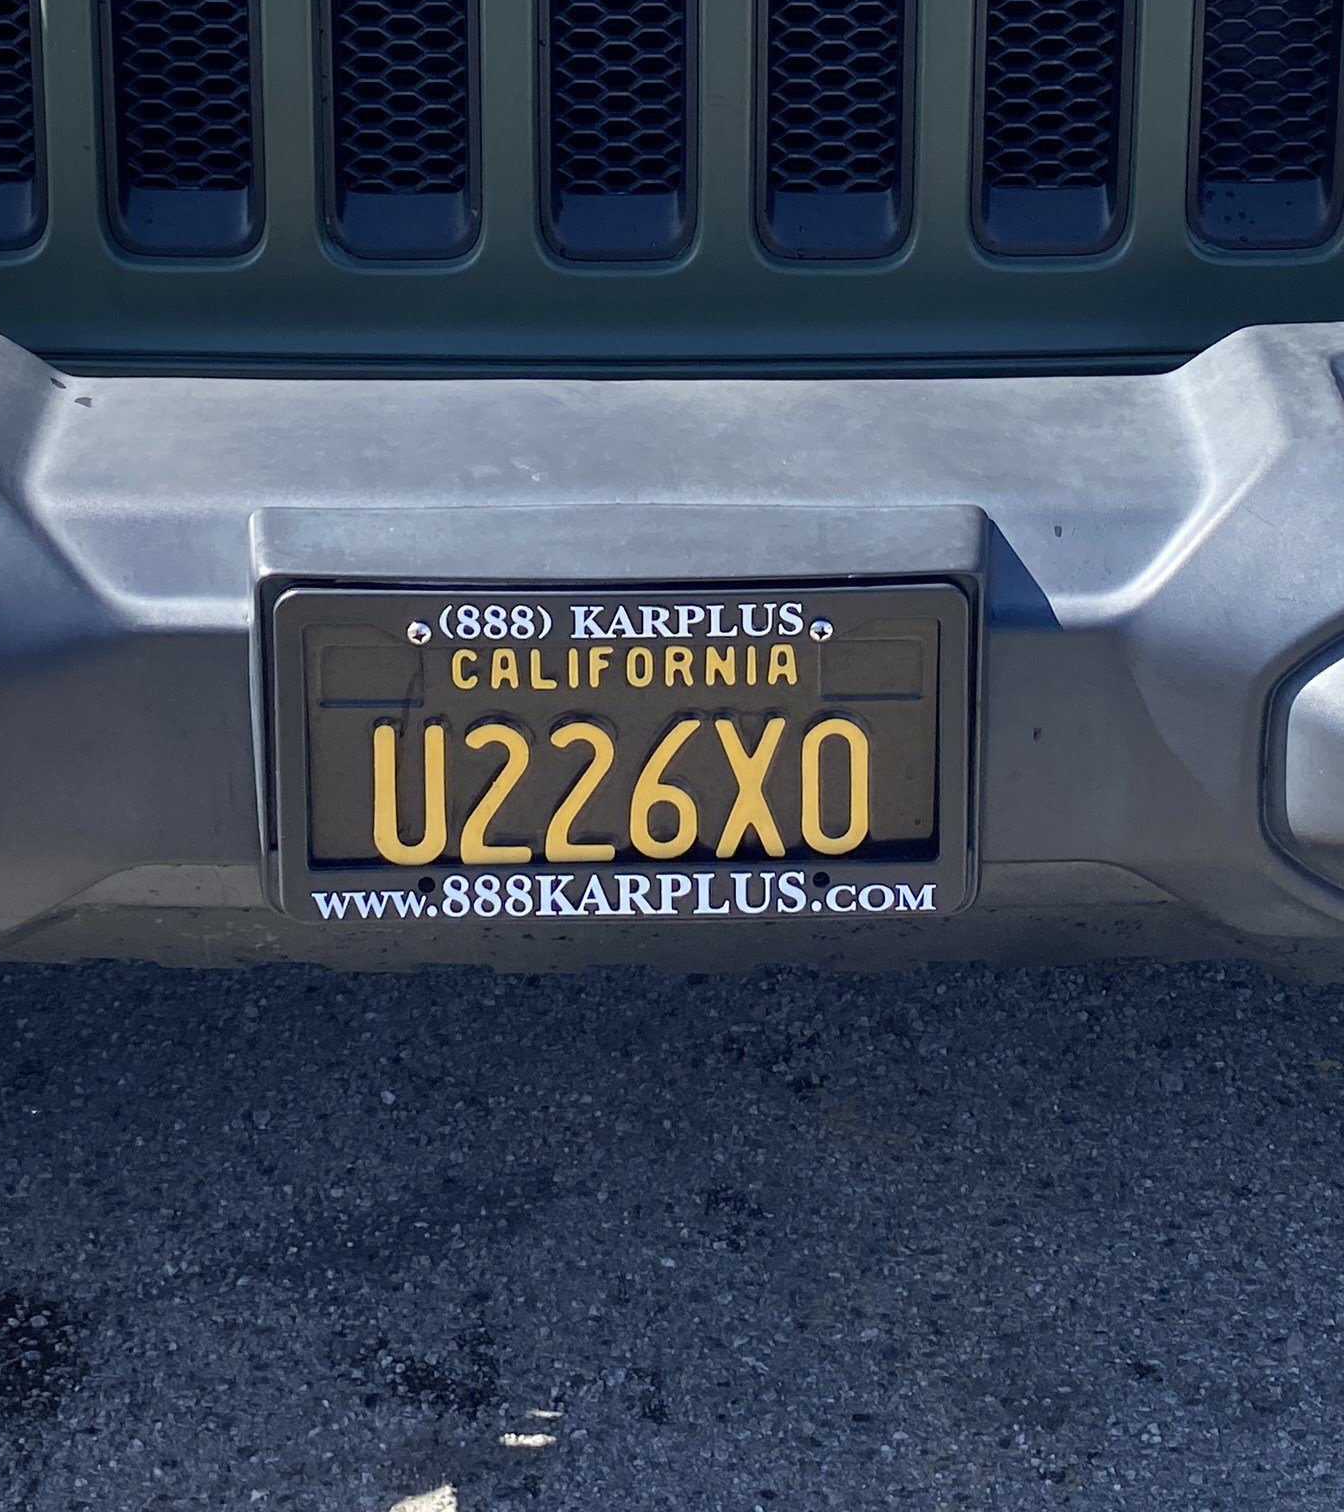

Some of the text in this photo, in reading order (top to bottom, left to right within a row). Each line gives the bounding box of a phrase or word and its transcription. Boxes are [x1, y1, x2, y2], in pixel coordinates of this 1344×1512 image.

[438, 602, 805, 639] (888) KARPLUS
[451, 643, 798, 690] CALIFORNIA
